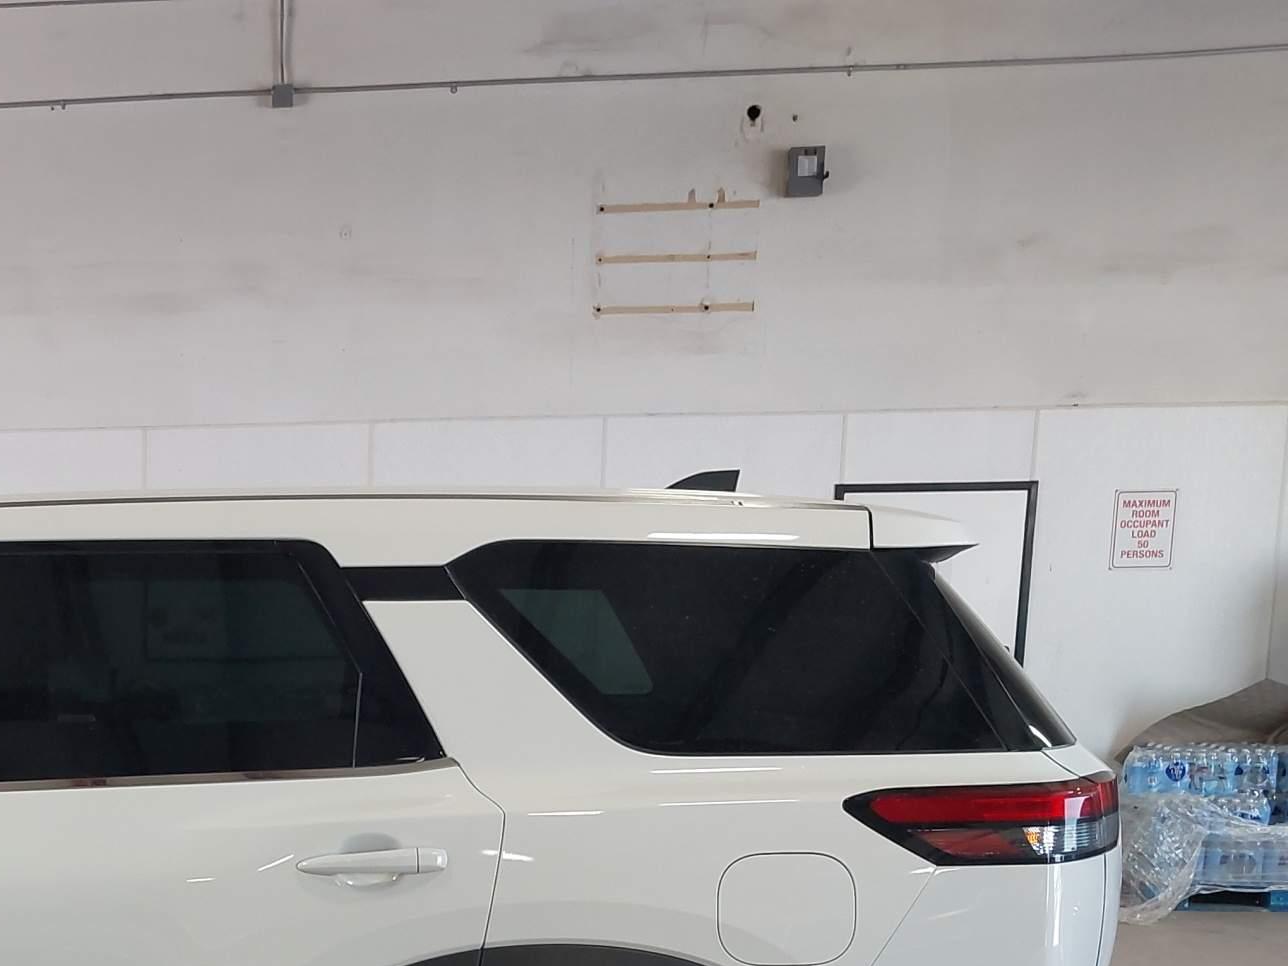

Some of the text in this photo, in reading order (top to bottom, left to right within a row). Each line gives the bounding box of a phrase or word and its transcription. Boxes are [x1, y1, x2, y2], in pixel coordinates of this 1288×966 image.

[1122, 499, 1171, 508] MAXIMUM
[1131, 509, 1160, 518] ROOM
[1120, 519, 1170, 528] OCCUPANT
[1131, 529, 1156, 538] LOAD
[1137, 540, 1149, 548] 50
[1120, 550, 1164, 559] PERSONS
